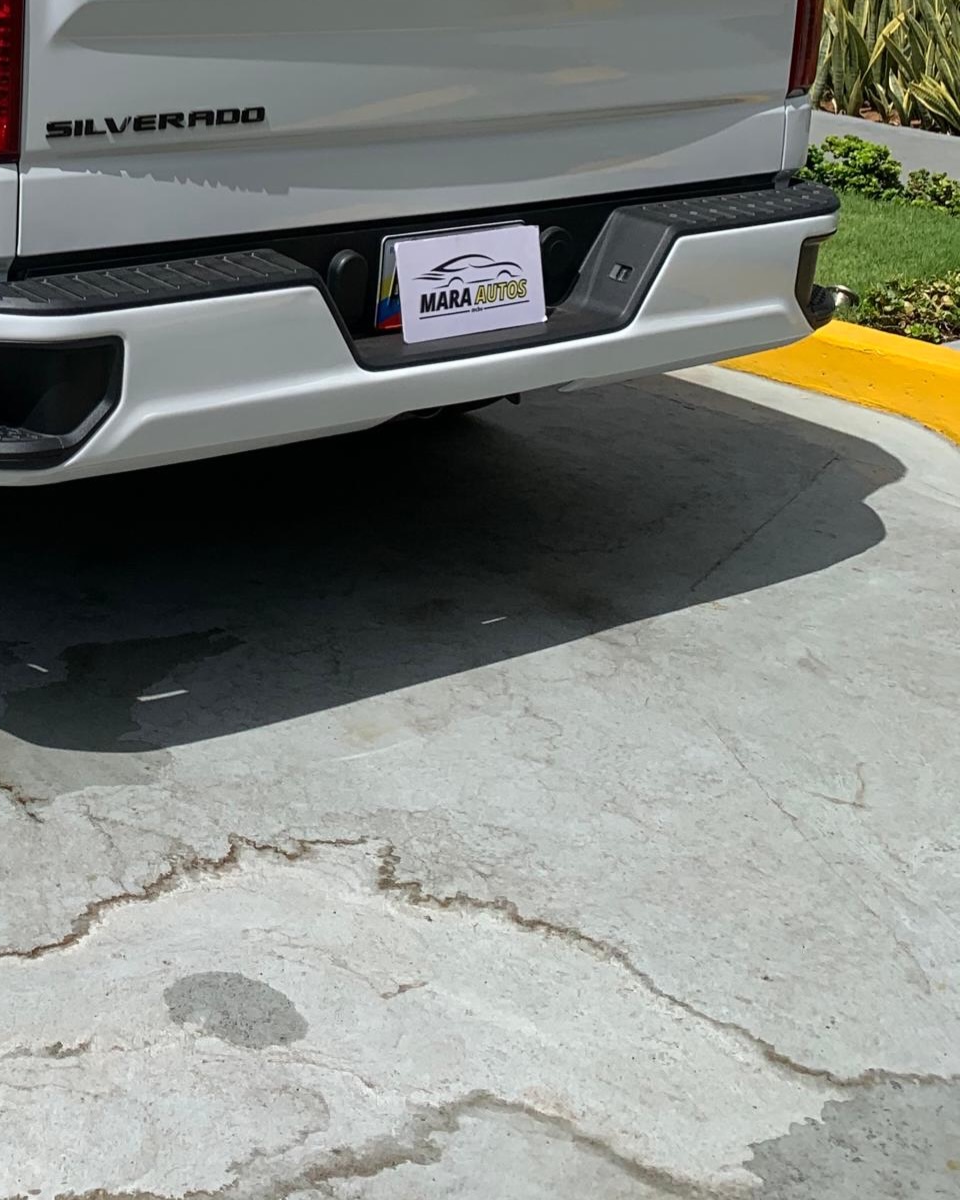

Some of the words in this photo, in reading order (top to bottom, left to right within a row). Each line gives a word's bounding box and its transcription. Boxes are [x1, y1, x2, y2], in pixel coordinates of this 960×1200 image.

[45, 106, 266, 138] SILVERADO
[419, 288, 472, 314] MARA
[474, 279, 528, 305] AUTOS
